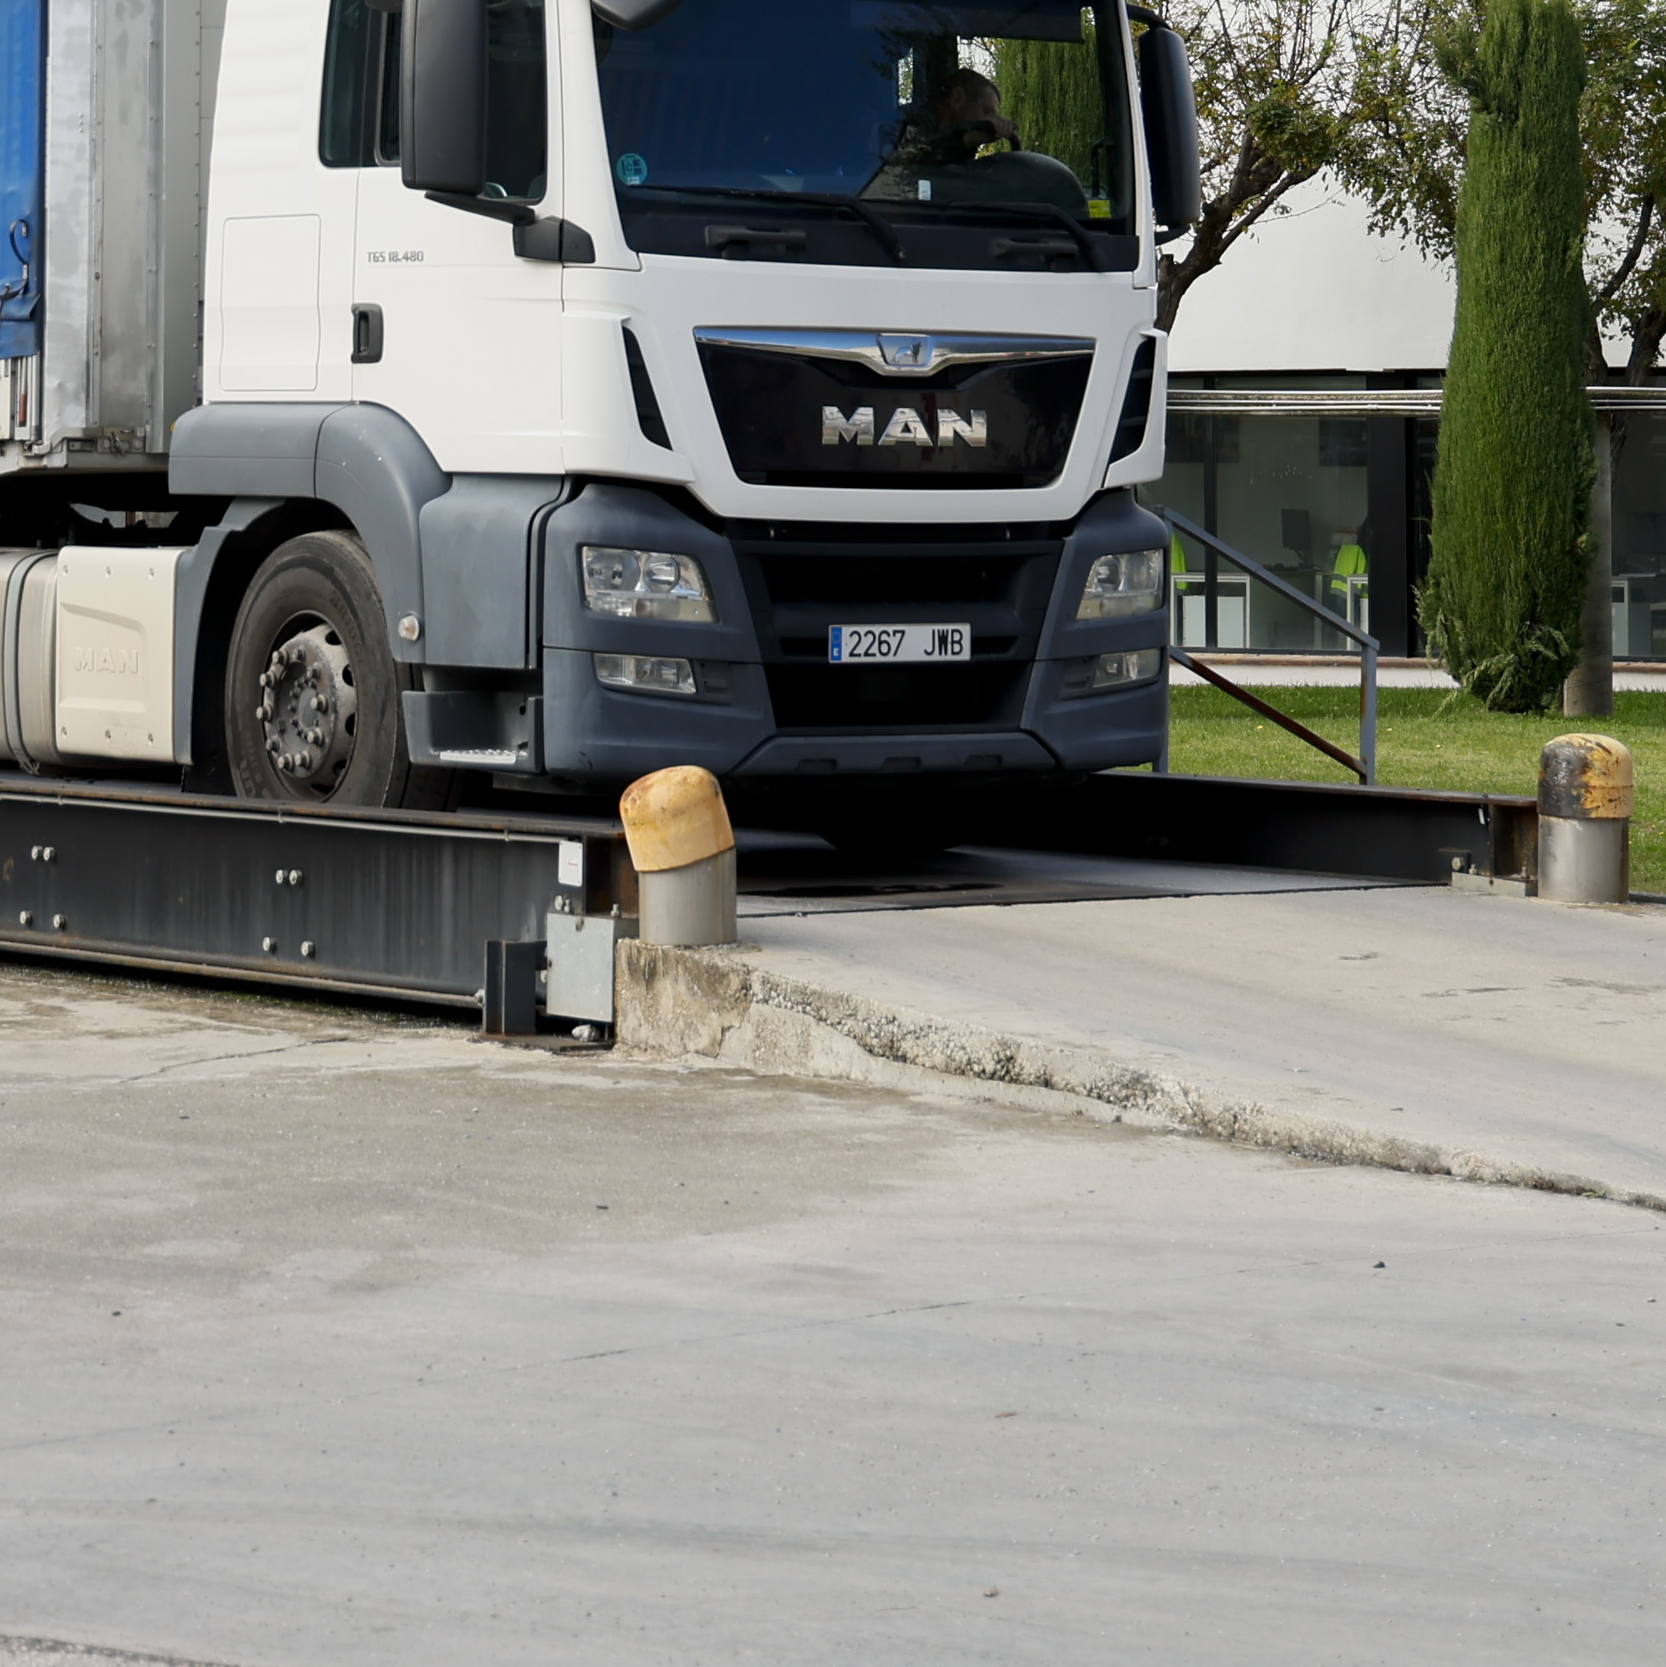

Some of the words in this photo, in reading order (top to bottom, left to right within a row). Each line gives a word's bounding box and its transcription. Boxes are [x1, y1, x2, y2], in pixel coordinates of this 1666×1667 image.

[821, 405, 988, 447] MAN
[848, 629, 906, 658] 2267
[923, 628, 964, 657] JWB
[74, 646, 139, 675] MAN
